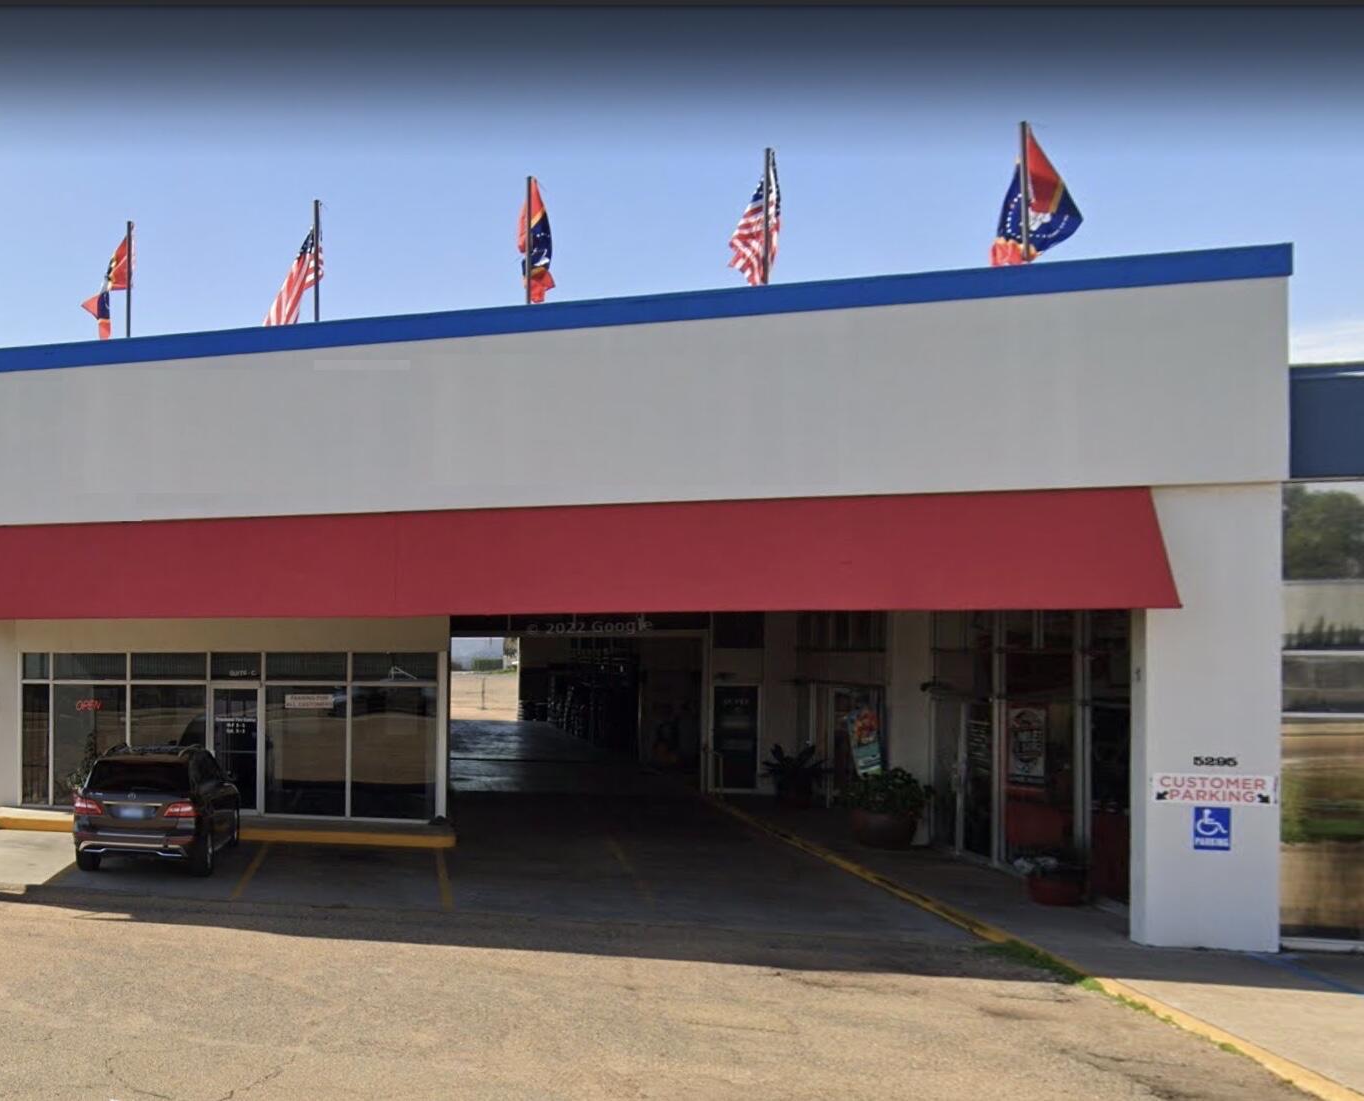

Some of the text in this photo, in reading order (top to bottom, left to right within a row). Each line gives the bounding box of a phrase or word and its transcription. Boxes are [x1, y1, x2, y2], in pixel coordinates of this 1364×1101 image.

[76, 699, 102, 712] OPEN
[1193, 756, 1238, 767] 5295
[1159, 775, 1266, 790] CUSTOMER
[1169, 789, 1255, 803] PARKING
